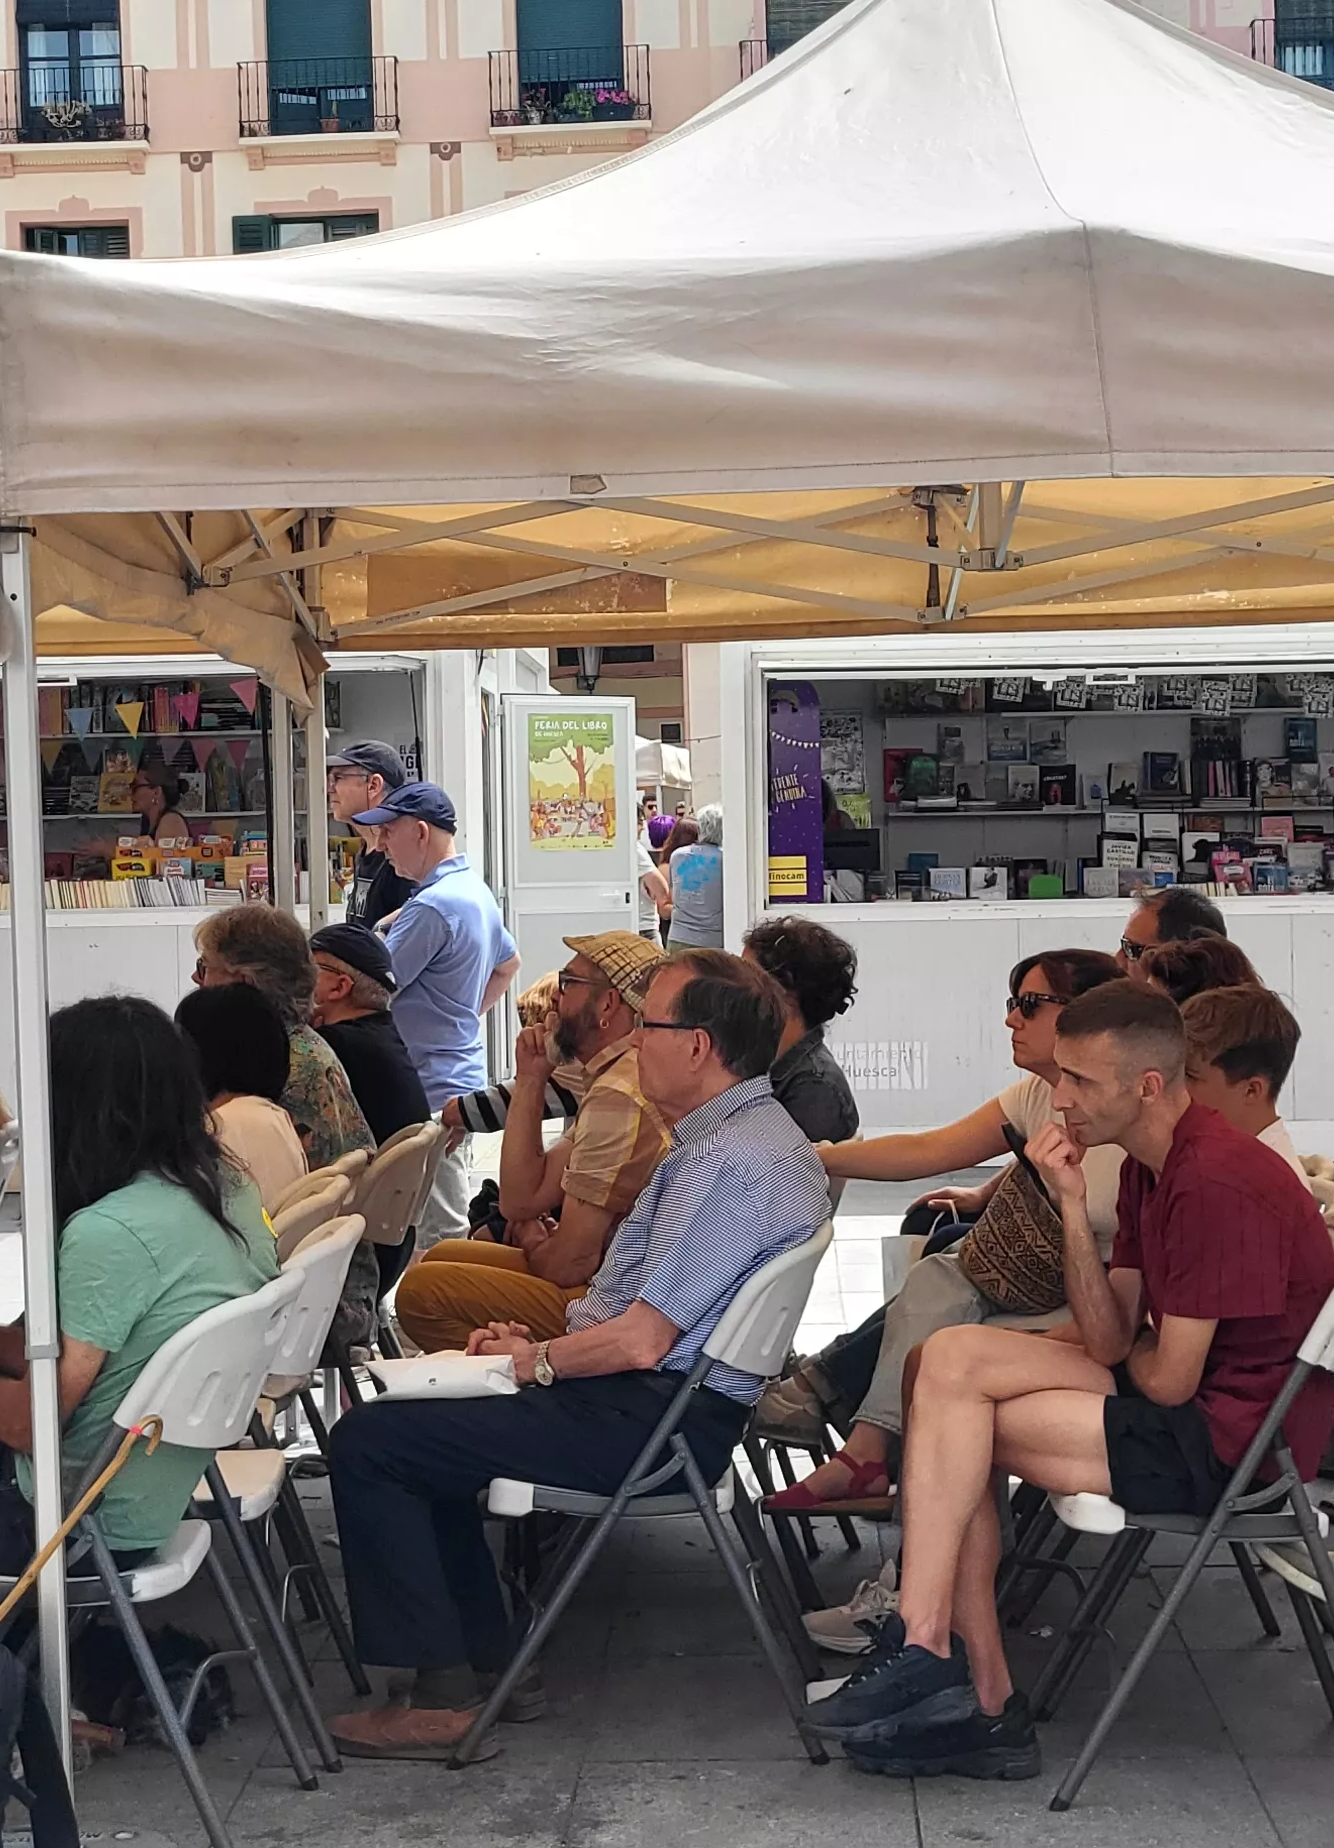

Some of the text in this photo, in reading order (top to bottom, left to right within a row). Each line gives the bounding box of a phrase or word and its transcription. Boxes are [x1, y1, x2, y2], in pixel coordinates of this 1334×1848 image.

[534, 720, 608, 730] FERIA DEL LIBRO
